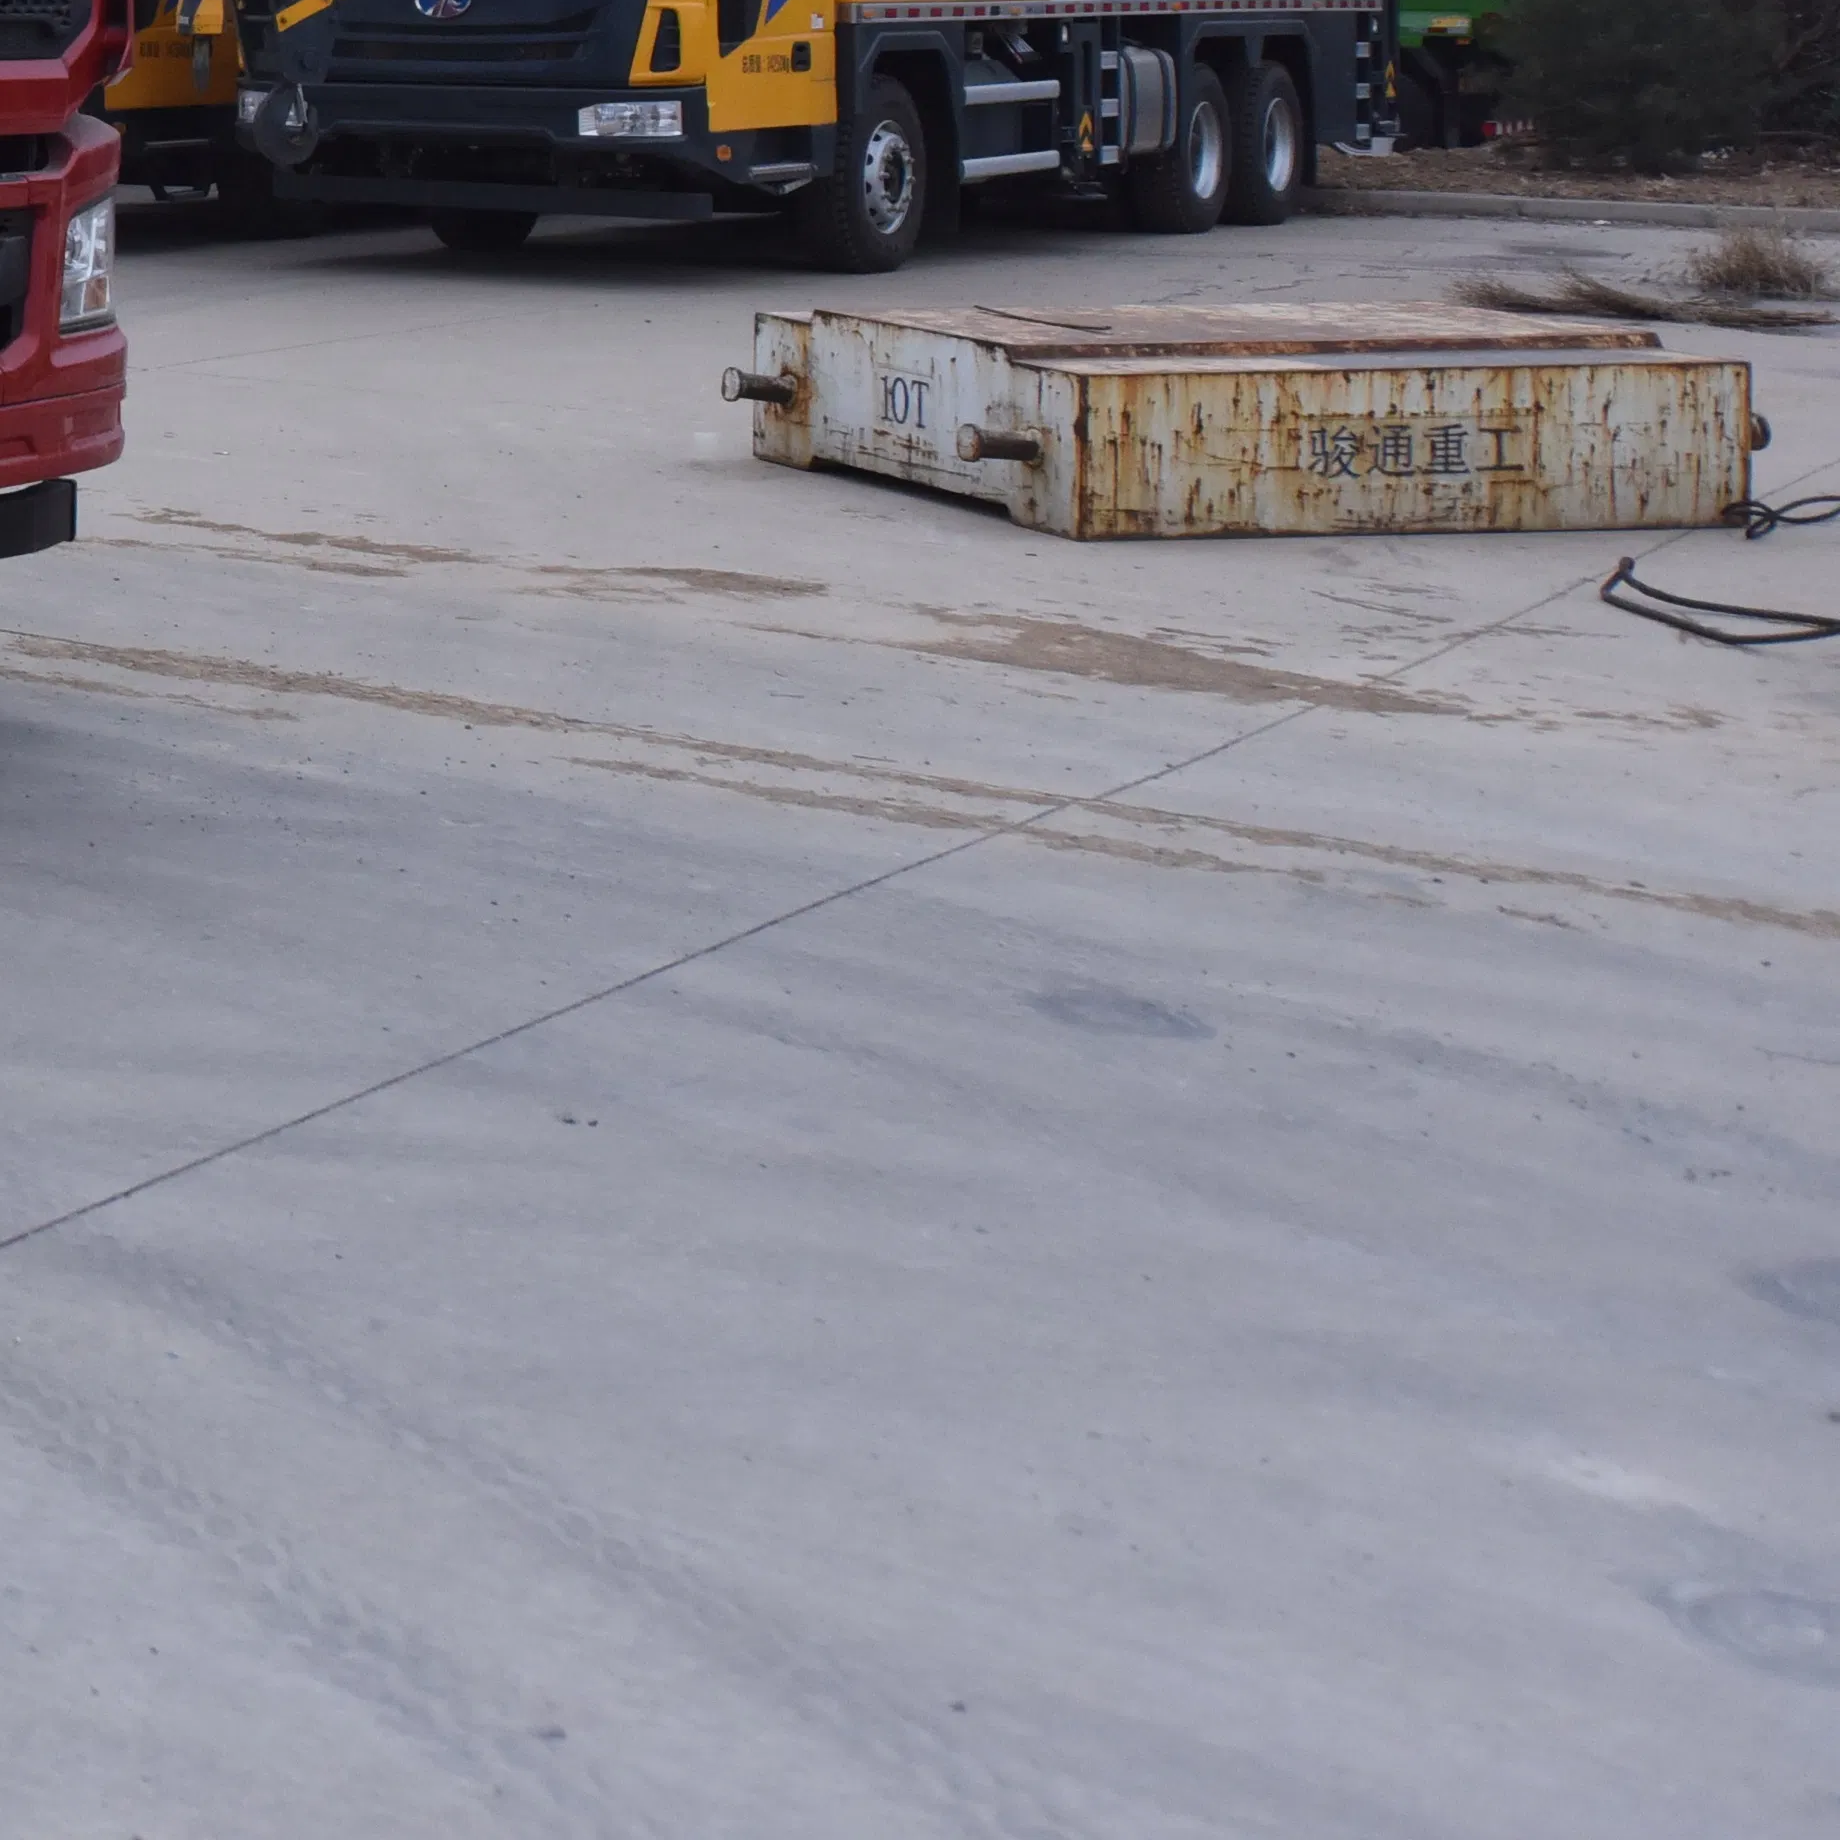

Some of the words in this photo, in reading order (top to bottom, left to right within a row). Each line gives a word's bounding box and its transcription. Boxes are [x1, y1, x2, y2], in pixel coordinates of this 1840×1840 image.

[880, 375, 930, 429] 10T
[1307, 423, 1524, 479] 骏通重工
